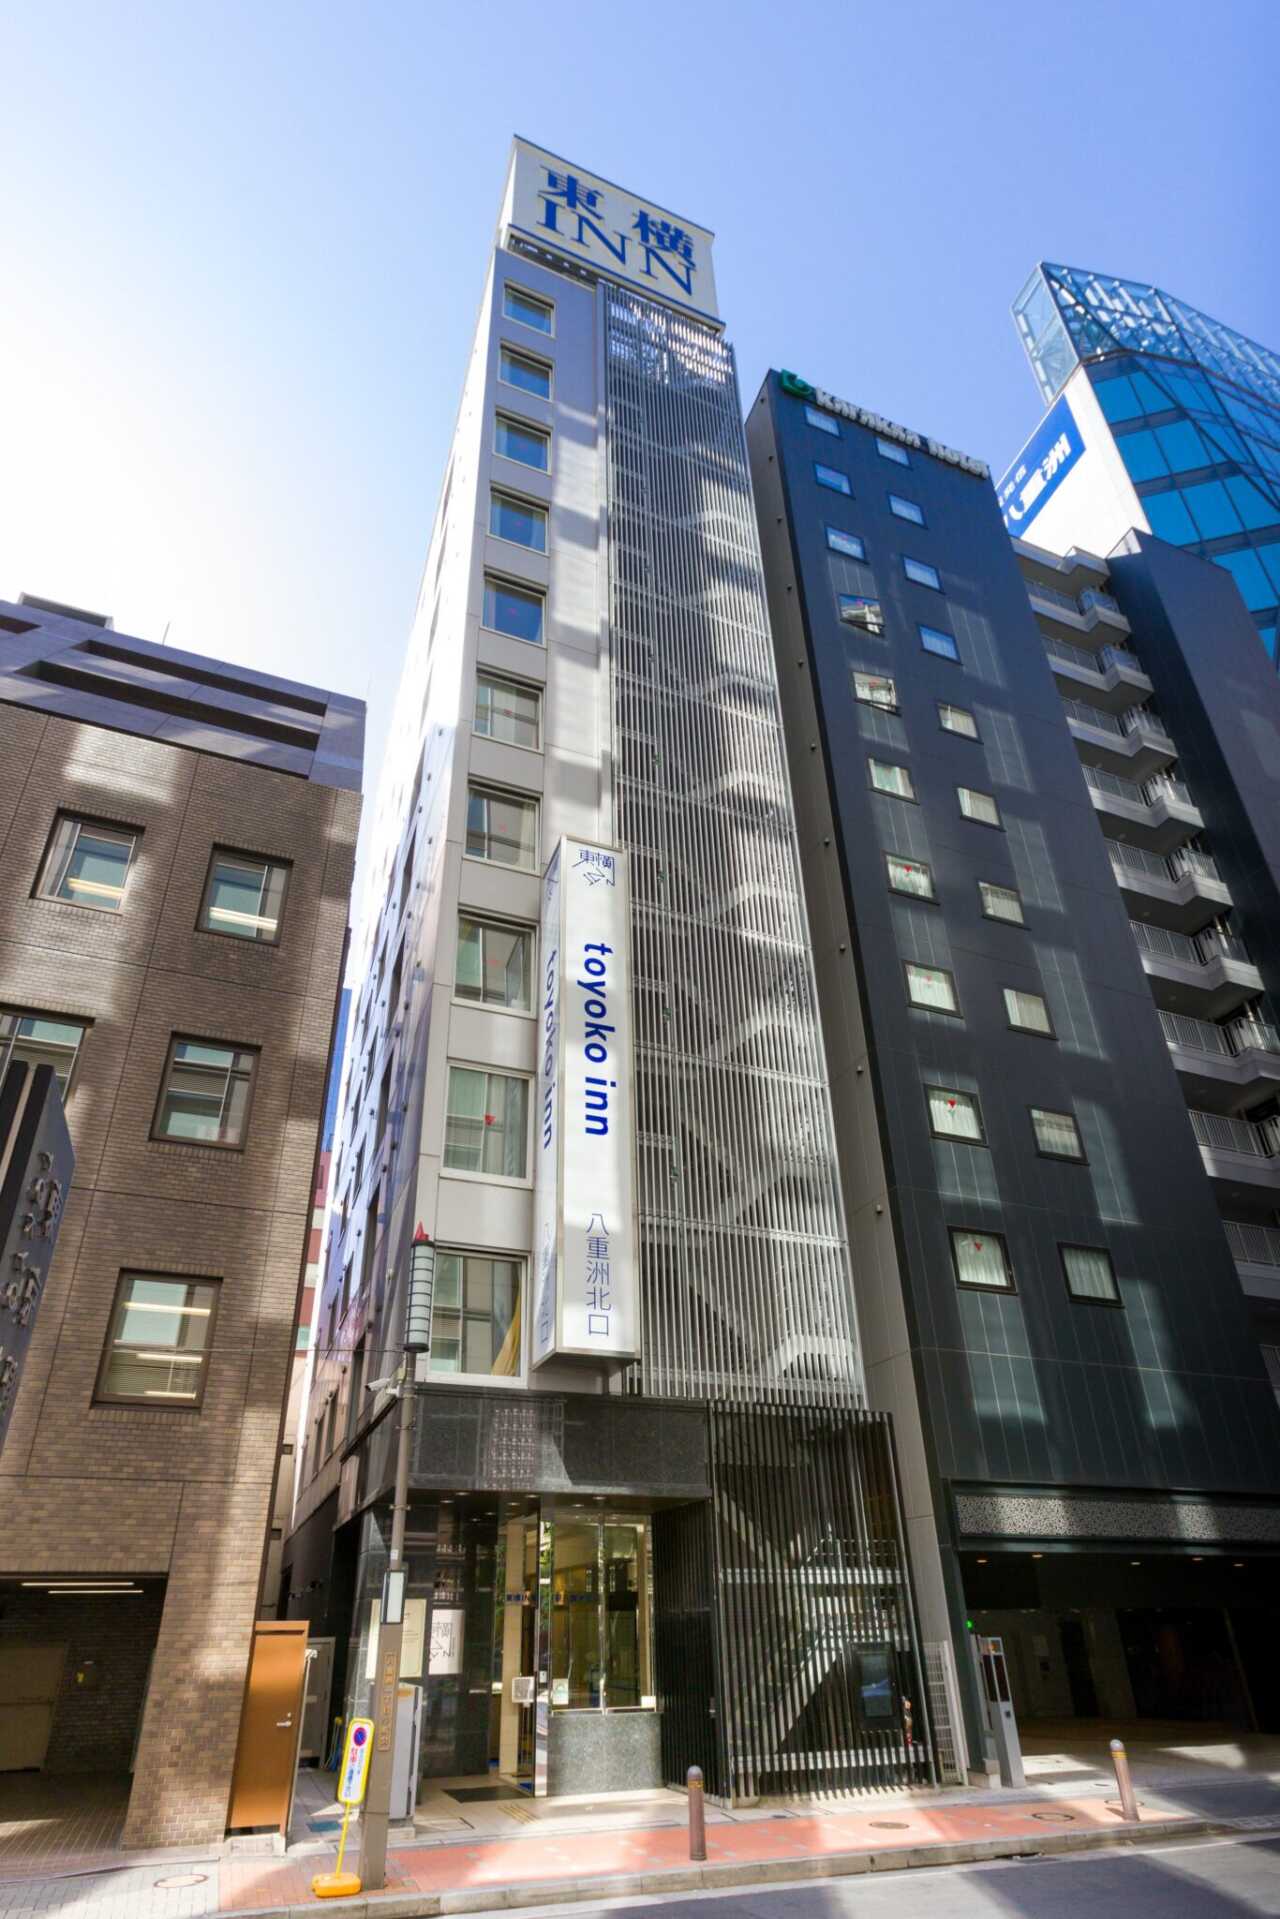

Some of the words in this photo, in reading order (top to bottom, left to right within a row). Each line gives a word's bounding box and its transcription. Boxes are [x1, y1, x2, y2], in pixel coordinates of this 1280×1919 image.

[536, 194, 697, 296] INN
[577, 943, 616, 1064] toyoko
[584, 1076, 617, 1136] inn
[585, 1212, 612, 1337] 八重洲北口
